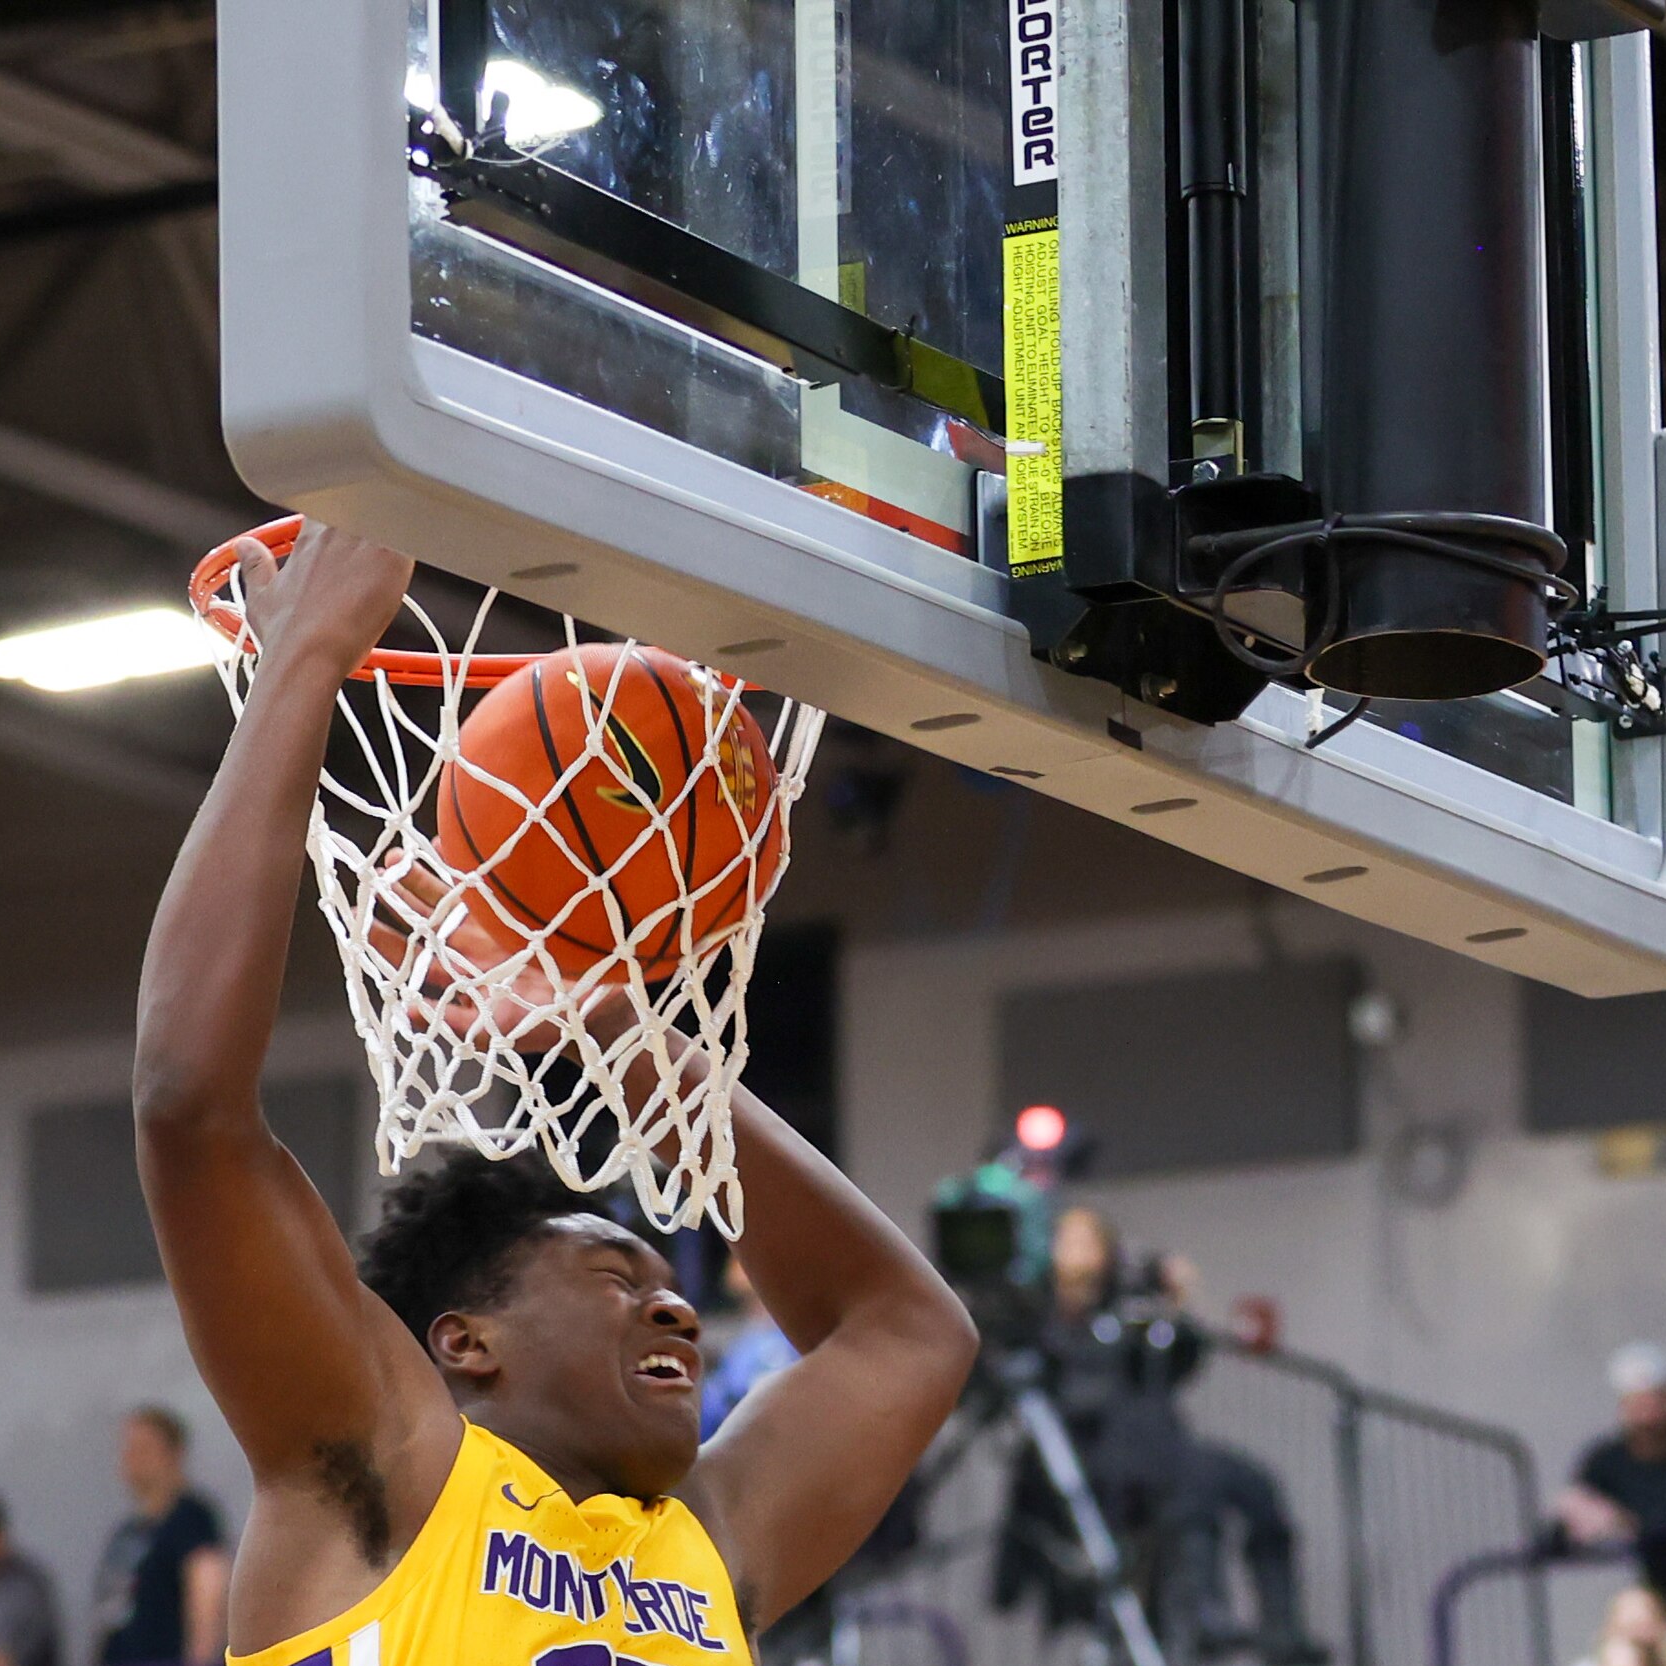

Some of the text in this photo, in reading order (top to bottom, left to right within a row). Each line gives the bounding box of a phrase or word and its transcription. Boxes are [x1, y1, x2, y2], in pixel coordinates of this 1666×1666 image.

[1013, 246, 1024, 294] HEIGHT
[1037, 242, 1047, 297] ADJUST
[1013, 298, 1025, 385] ADJUSTMENT
[1036, 305, 1048, 344] GOAL
[1015, 388, 1026, 417] UNIT
[1024, 243, 1041, 552] HOISTING UNIT TO ELIMINATE UDUE STRAIN ON
[1038, 352, 1050, 405] HEIGHT
[1048, 239, 1063, 548] ON CEILING FOLD-UP BACKSTOPS ALWAYS
[1016, 422, 1026, 442] AN
[1039, 413, 1050, 433] TO
[1040, 491, 1052, 550] BEFORE
